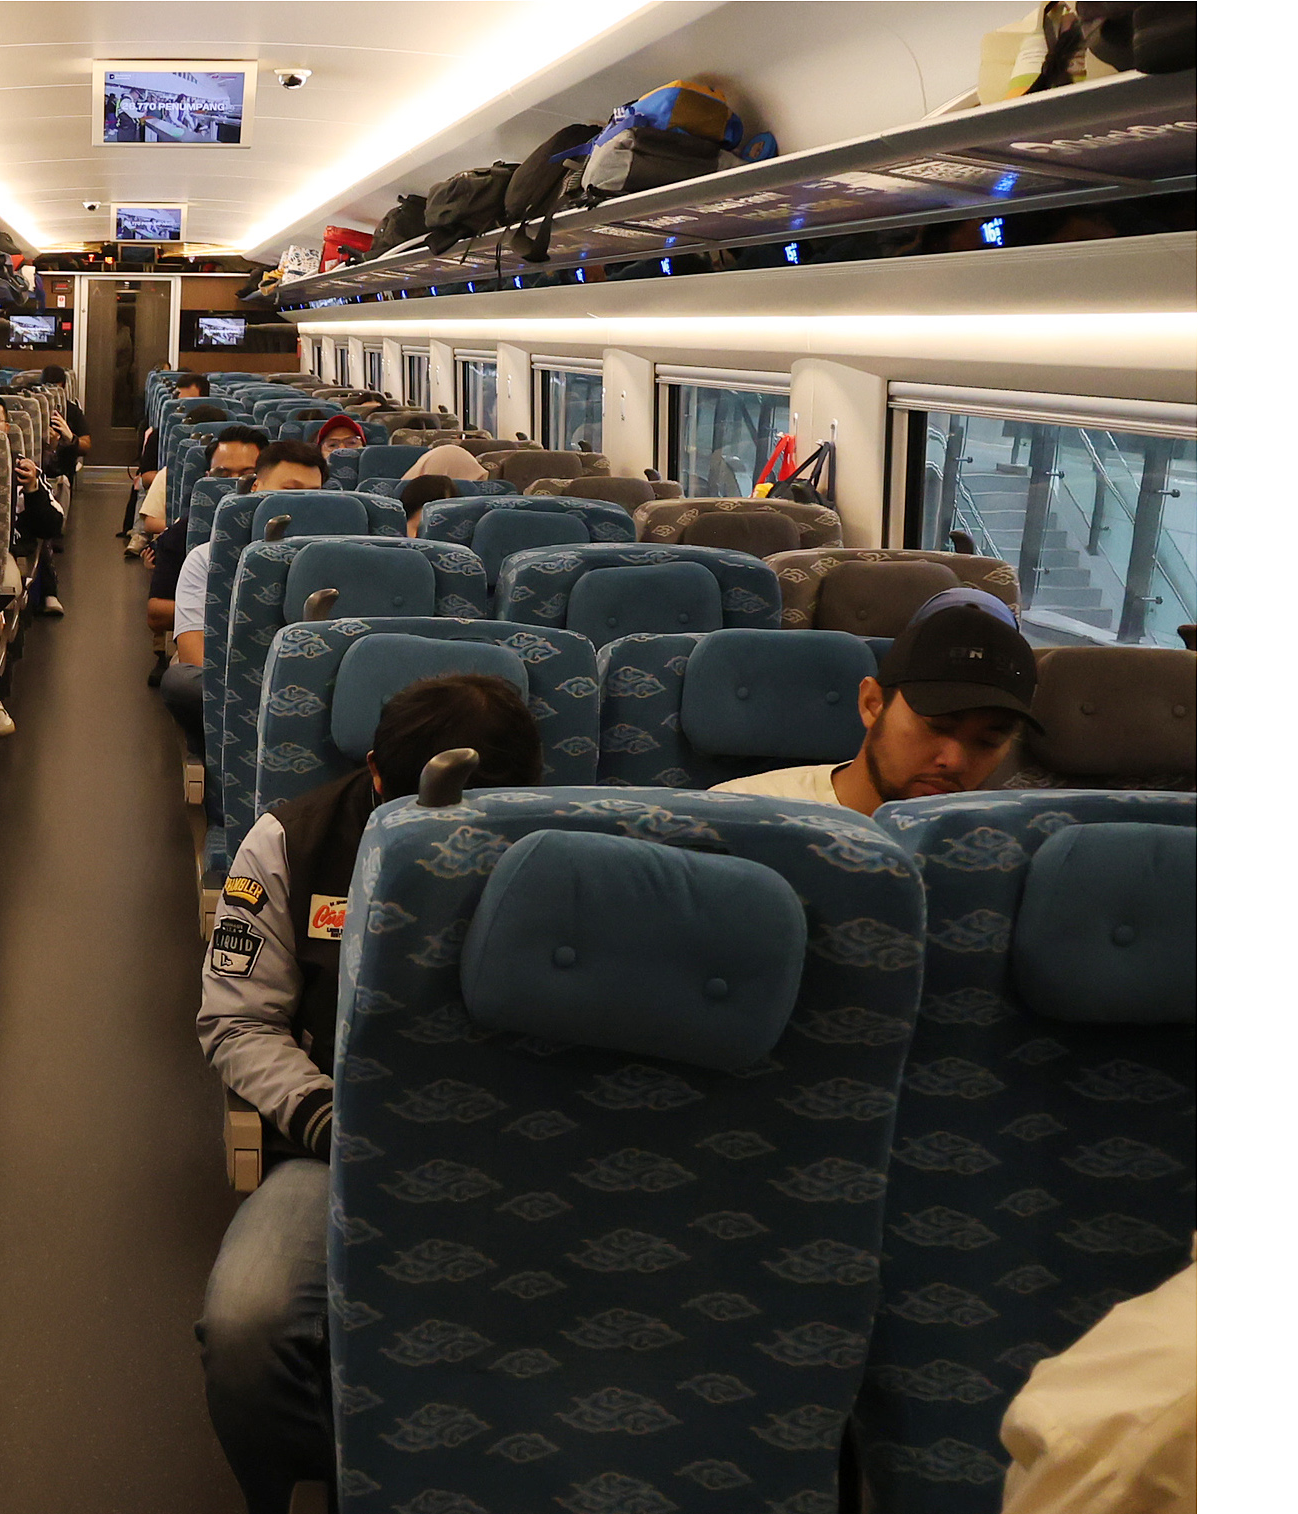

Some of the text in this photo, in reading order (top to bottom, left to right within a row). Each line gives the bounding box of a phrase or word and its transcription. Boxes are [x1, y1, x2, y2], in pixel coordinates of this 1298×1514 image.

[158, 102, 225, 111] PENUMPANG
[982, 222, 996, 242] 16
[216, 934, 253, 952] LIQUID
